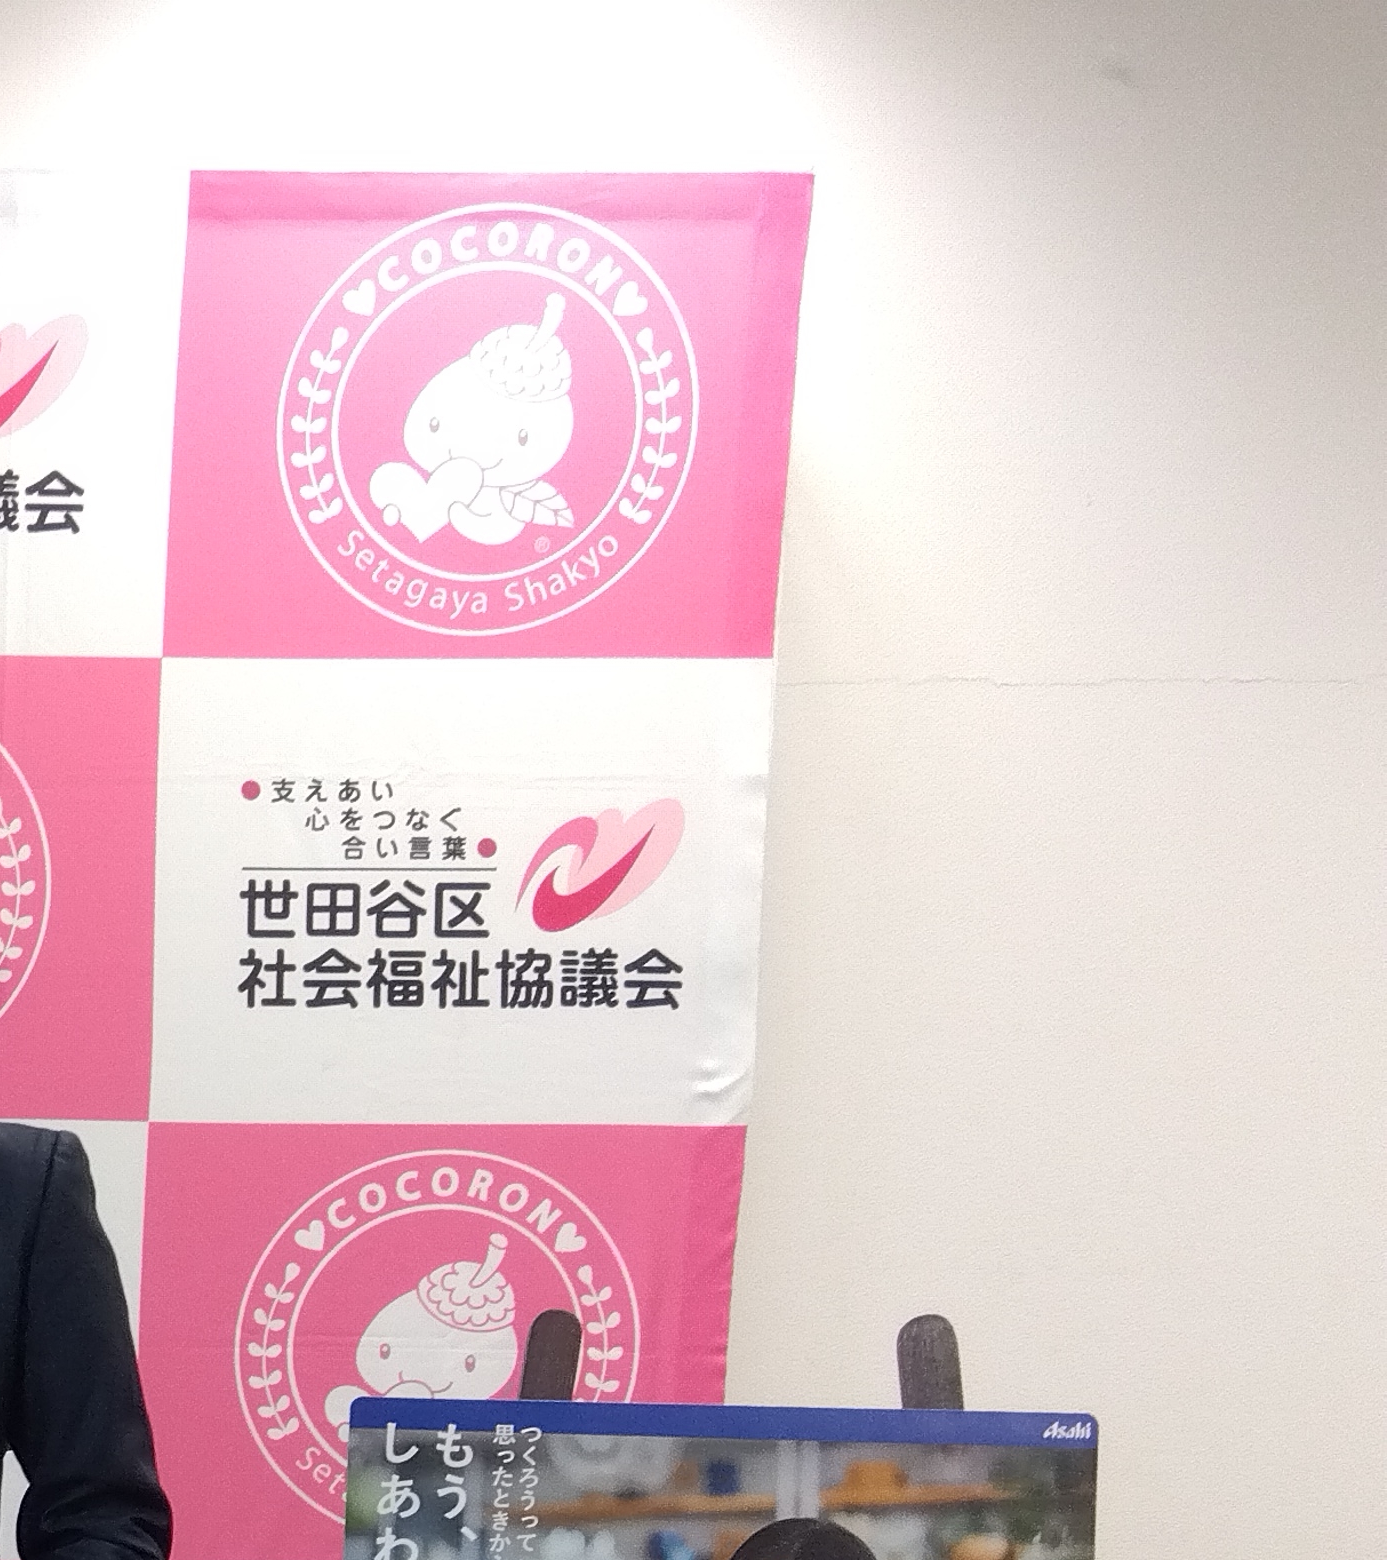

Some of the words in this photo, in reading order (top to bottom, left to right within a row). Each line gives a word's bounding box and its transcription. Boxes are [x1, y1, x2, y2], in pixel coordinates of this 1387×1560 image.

[376, 222, 624, 297] COCORON
[336, 528, 489, 621] Setagaya
[503, 534, 619, 613] Shakyo
[270, 777, 395, 804] 支えあい
[305, 806, 462, 832] 心をつなく
[341, 835, 469, 862] 合い言葉
[239, 878, 492, 939] 世田谷区
[237, 946, 685, 1011] 社会福祉協議会
[326, 1166, 563, 1236] COCORON
[1042, 1420, 1092, 1440] Asahi
[296, 1445, 348, 1502] Set
[435, 1422, 478, 1542] もう、
[516, 1425, 544, 1552] つくろうって
